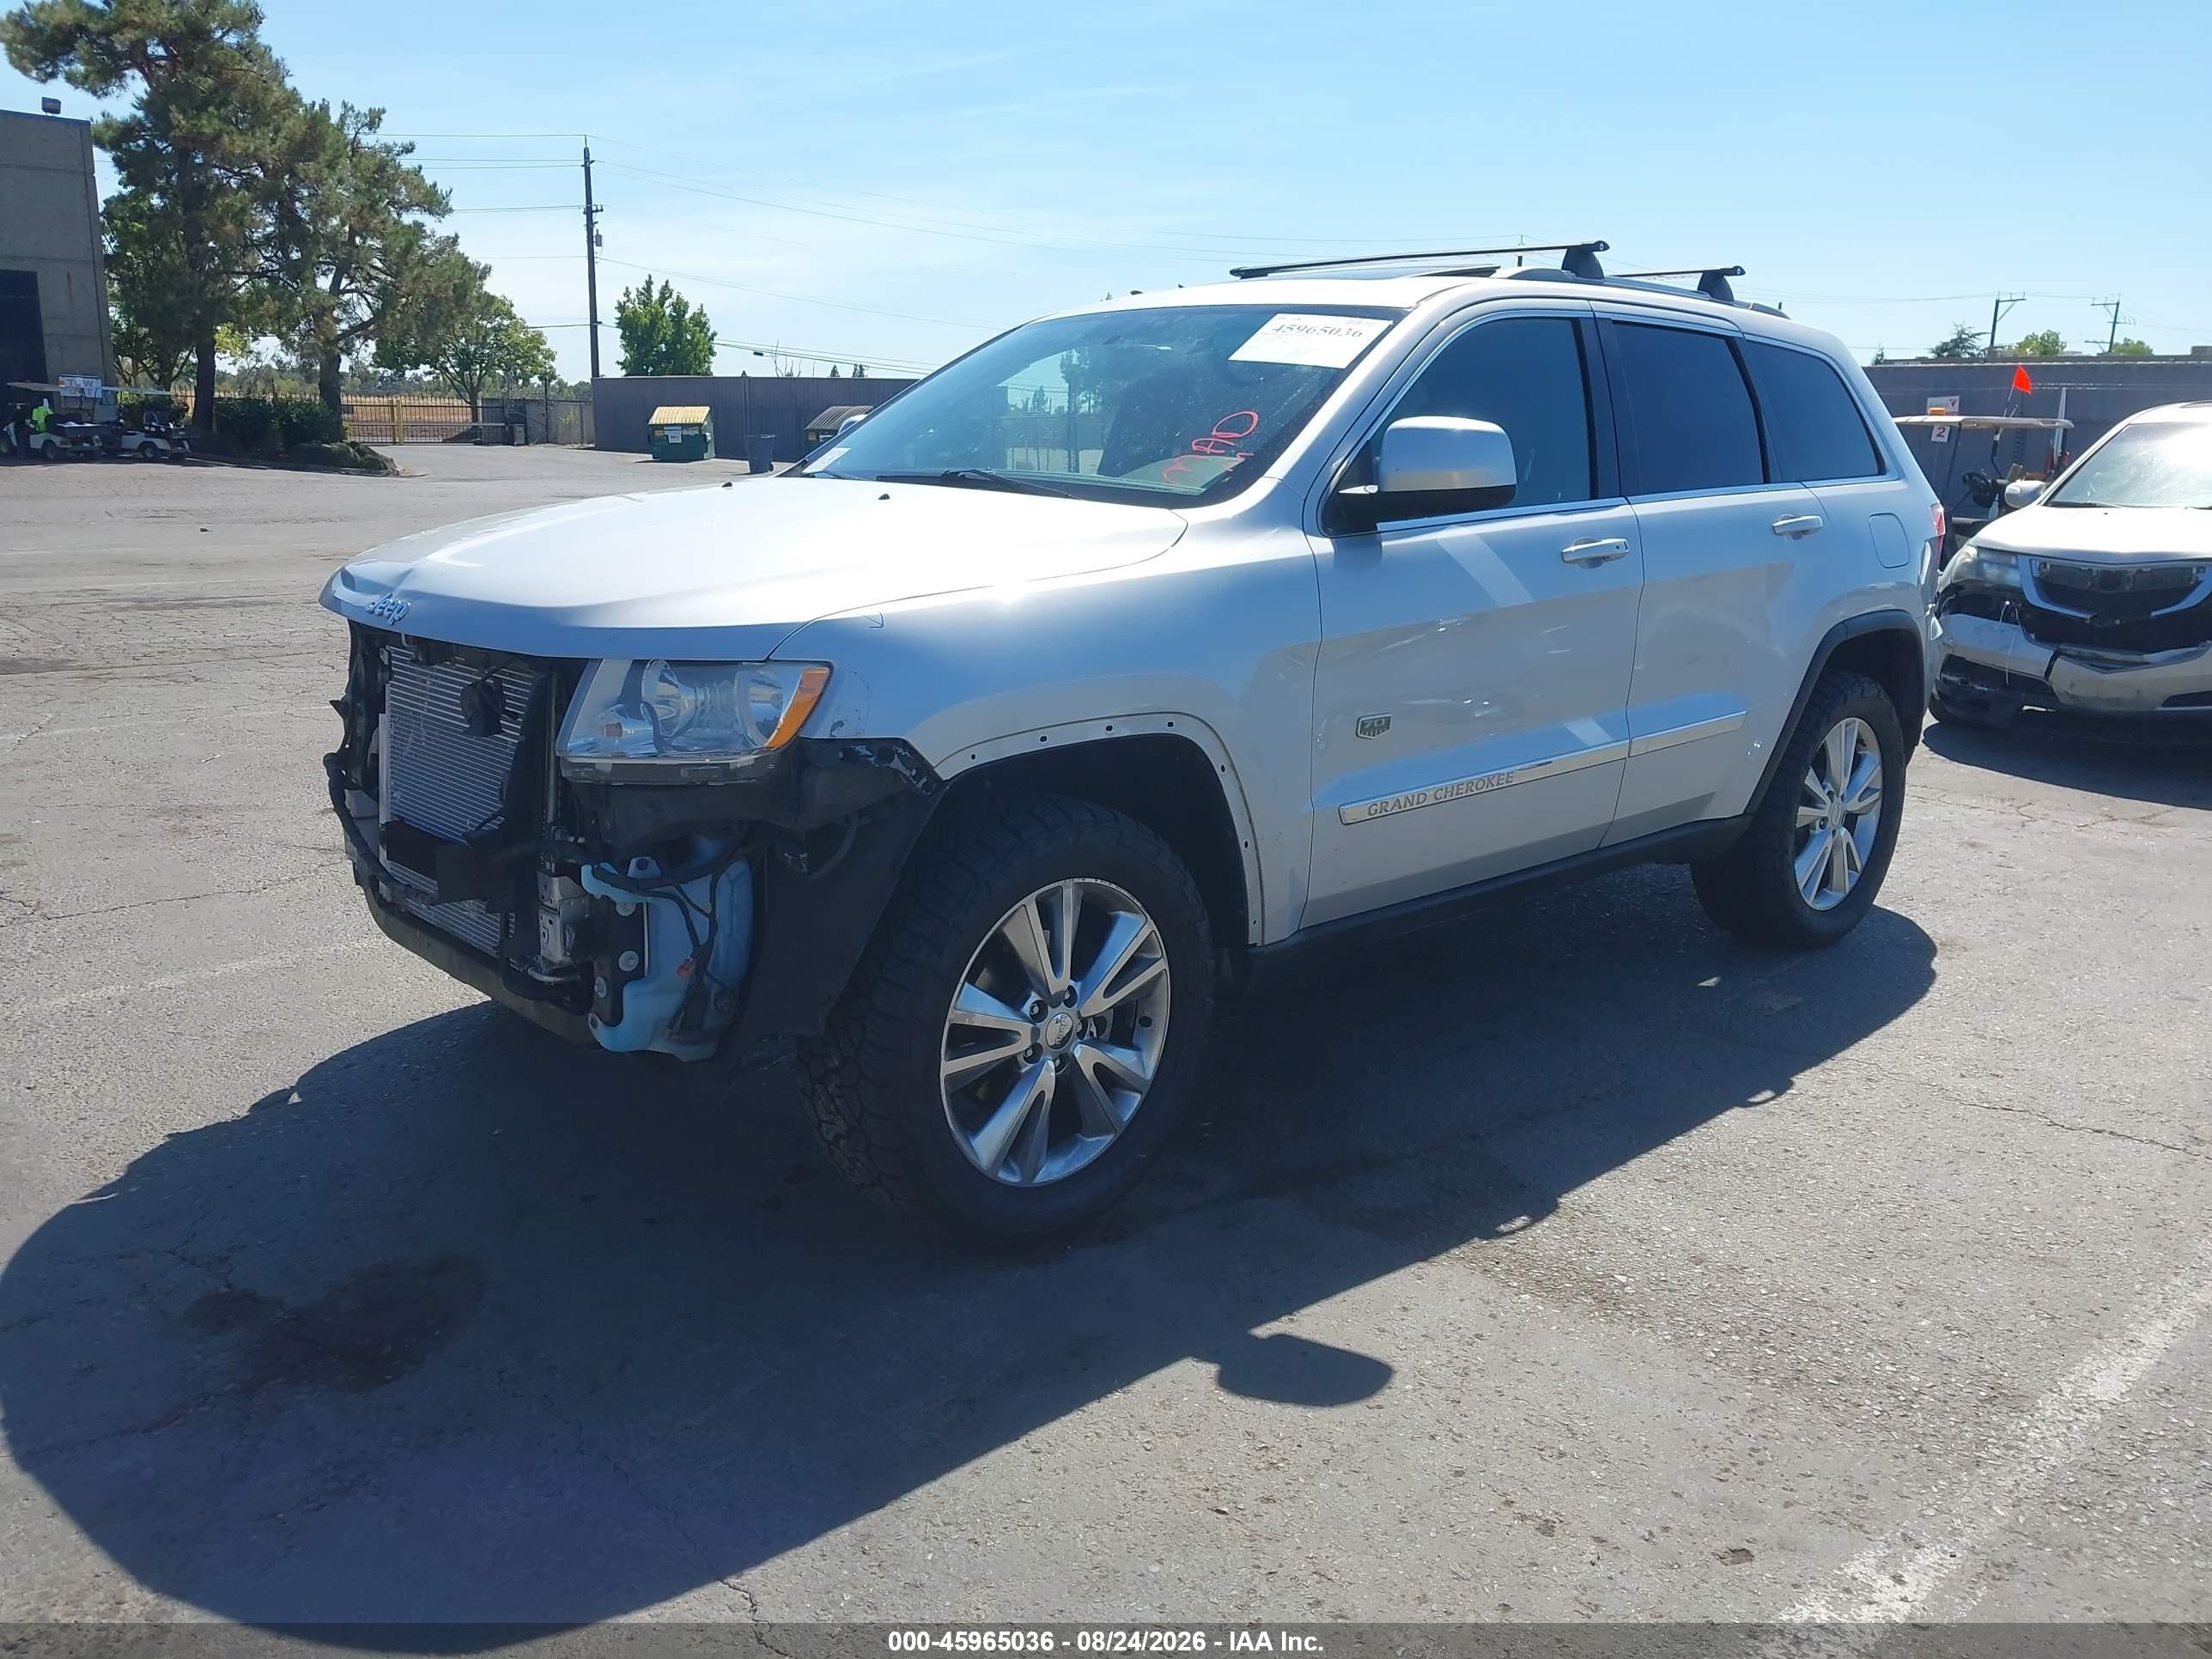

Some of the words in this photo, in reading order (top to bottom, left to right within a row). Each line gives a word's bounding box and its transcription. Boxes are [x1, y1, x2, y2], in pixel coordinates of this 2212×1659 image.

[1936, 427, 1946, 438] 2
[365, 592, 411, 626] Jeep
[1364, 718, 1386, 729] 70
[1367, 792, 1428, 817] GRAND
[1433, 771, 1515, 800] CHEROKEE
